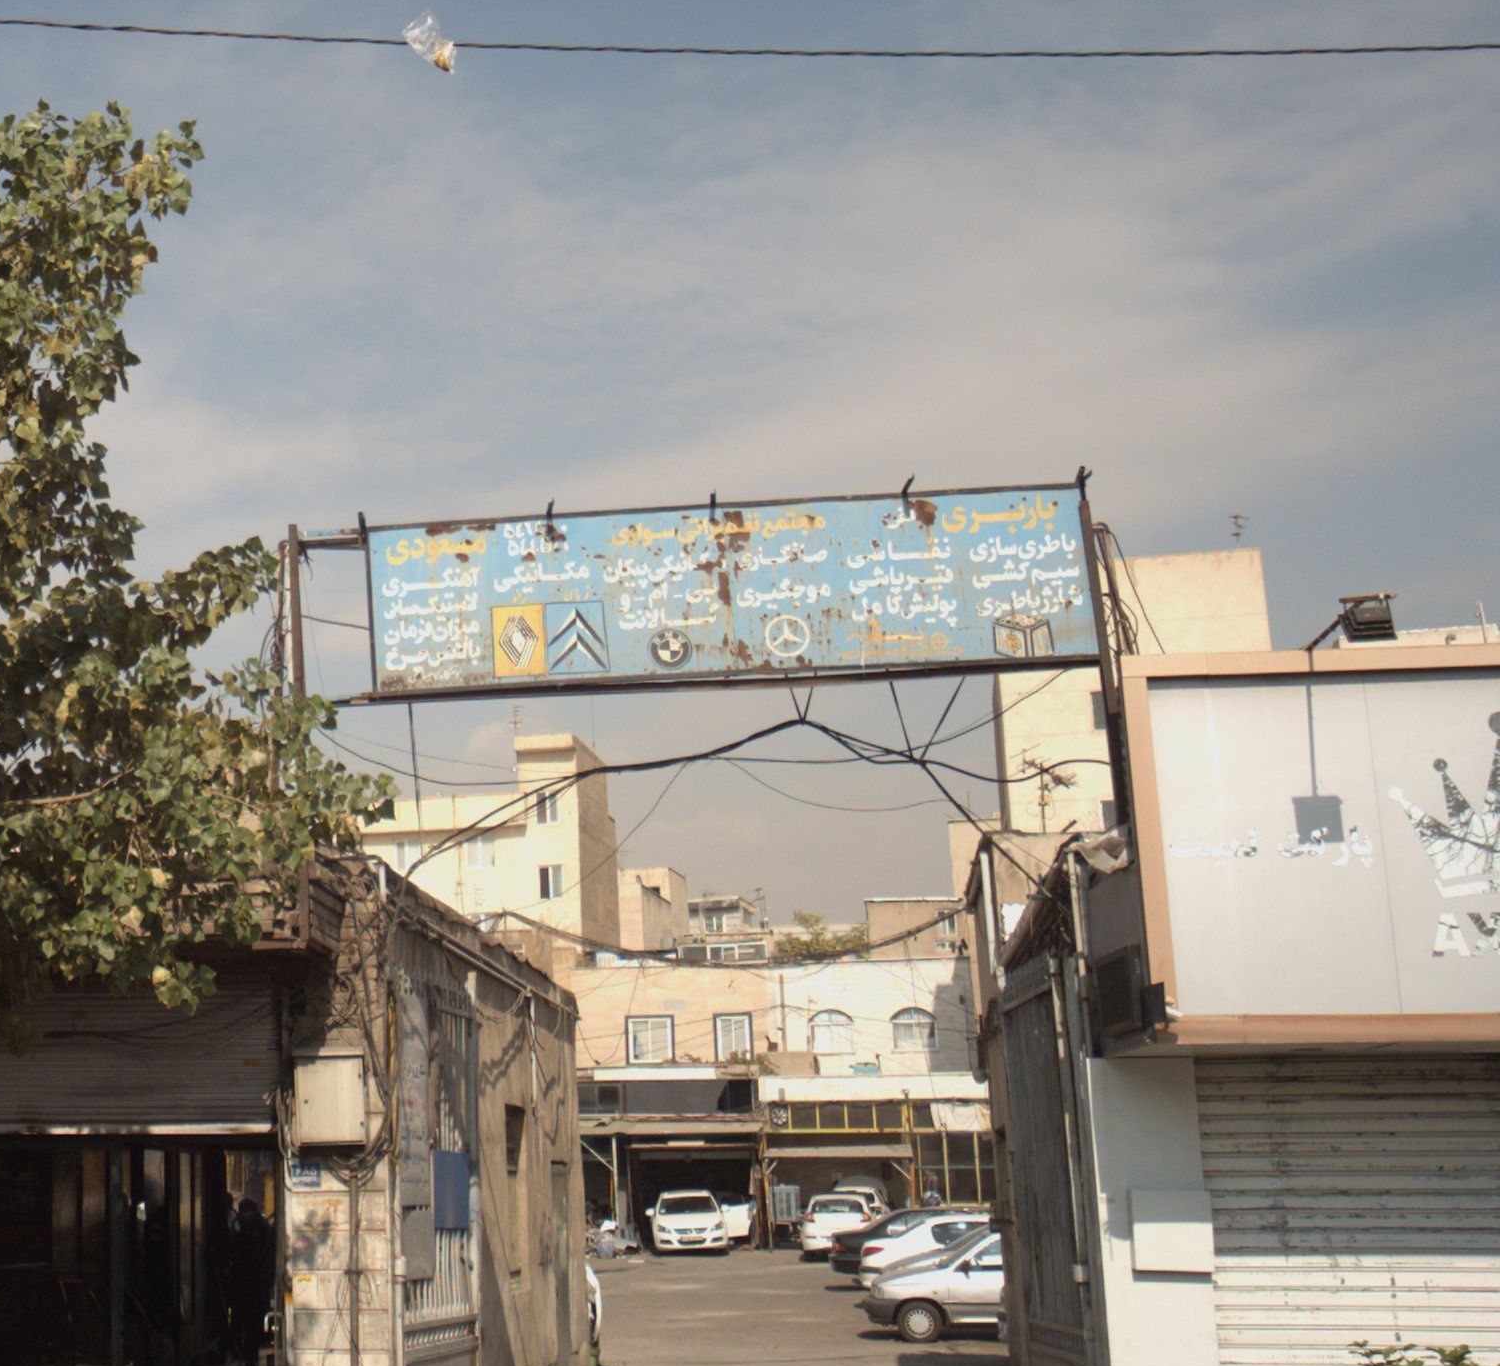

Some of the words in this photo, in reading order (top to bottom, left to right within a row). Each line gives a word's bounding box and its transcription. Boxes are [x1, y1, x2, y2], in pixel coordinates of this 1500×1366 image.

[942, 493, 1057, 533] باربری
[386, 536, 488, 565] مسعودی
[847, 538, 952, 569] نقاشی
[382, 567, 481, 597] آهنگری
[494, 562, 590, 593] مکانیکی
[972, 560, 1031, 589] کشی
[1031, 564, 1080, 586] سیم
